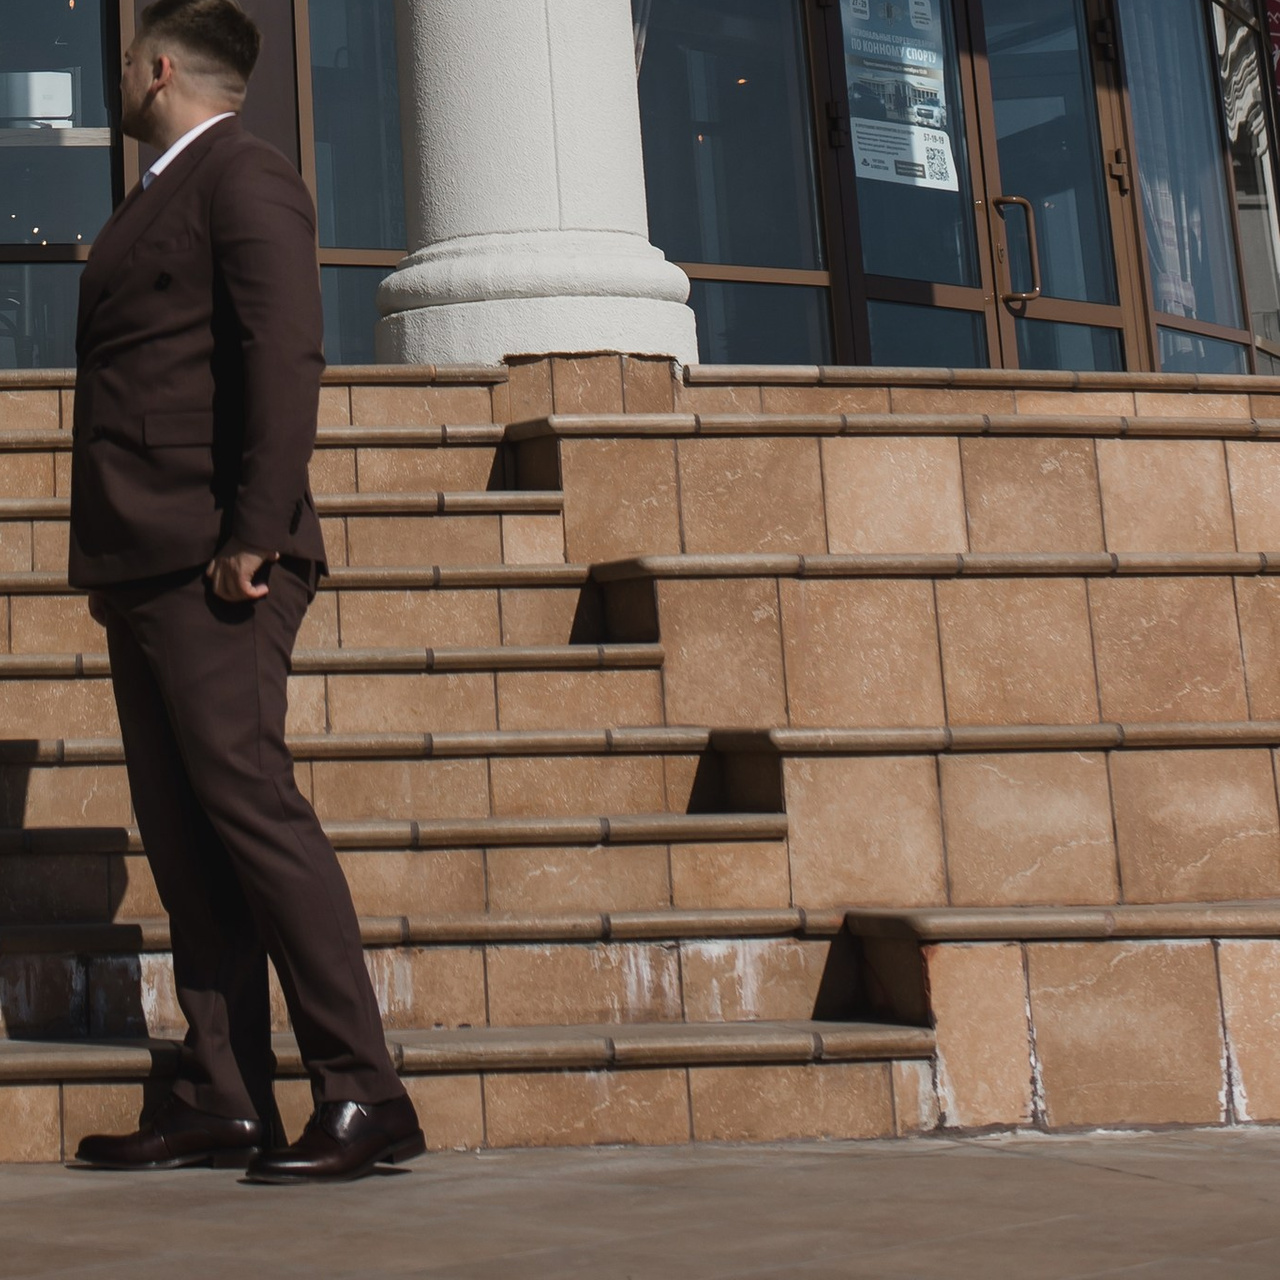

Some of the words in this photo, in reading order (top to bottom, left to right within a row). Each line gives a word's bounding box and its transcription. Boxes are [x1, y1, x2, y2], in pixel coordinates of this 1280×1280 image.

[851, 38, 862, 51] ПО
[863, 39, 905, 58] КОННОМУ
[906, 47, 937, 64] СПОРТУ
